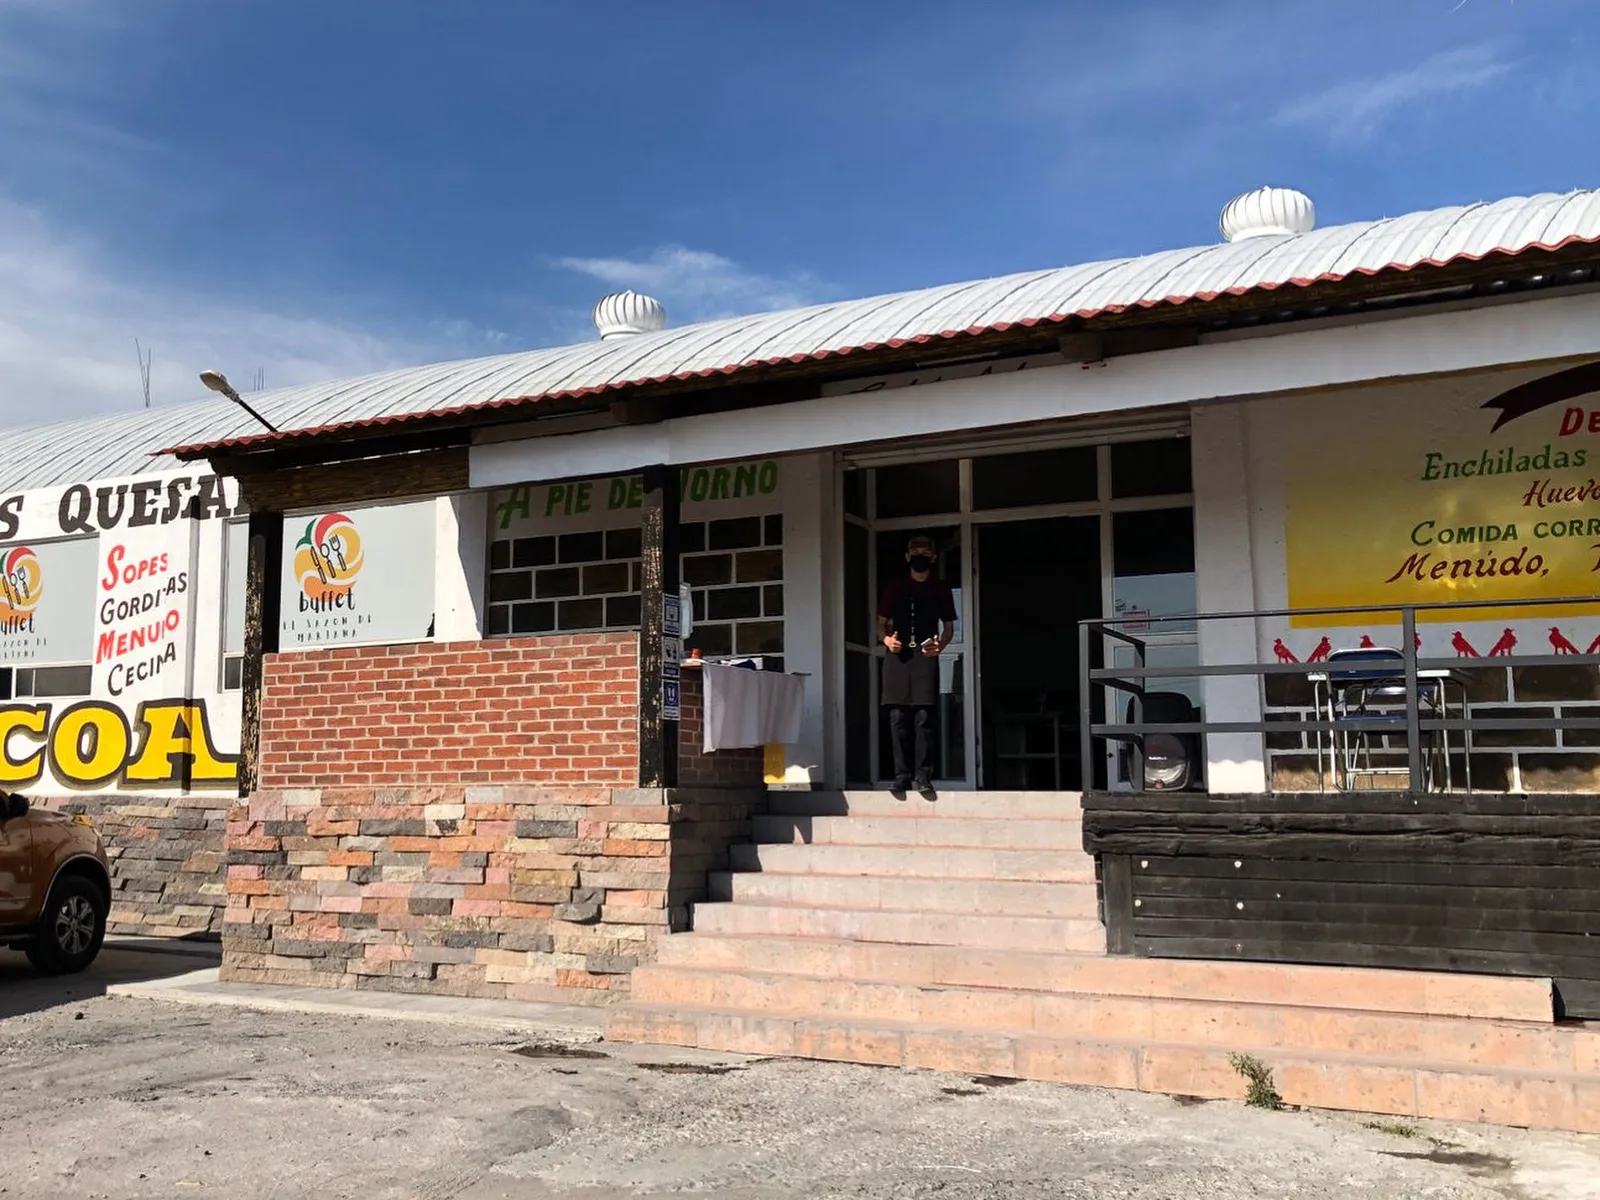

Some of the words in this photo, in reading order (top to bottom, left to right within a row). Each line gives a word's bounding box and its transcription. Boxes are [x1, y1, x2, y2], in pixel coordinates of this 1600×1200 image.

[1421, 444, 1588, 481] Enchiladas
[496, 486, 530, 530] A
[545, 482, 594, 517] PIE
[607, 477, 643, 511] DE
[680, 461, 779, 503] ORNO
[1411, 519, 1518, 546] COMIDA
[101, 544, 169, 591] SOPES
[1385, 546, 1551, 583] Menúdo,
[100, 572, 187, 625] GORDIAS
[299, 588, 356, 613] buffet
[0, 612, 35, 635] uffet
[95, 608, 180, 664] MENUO
